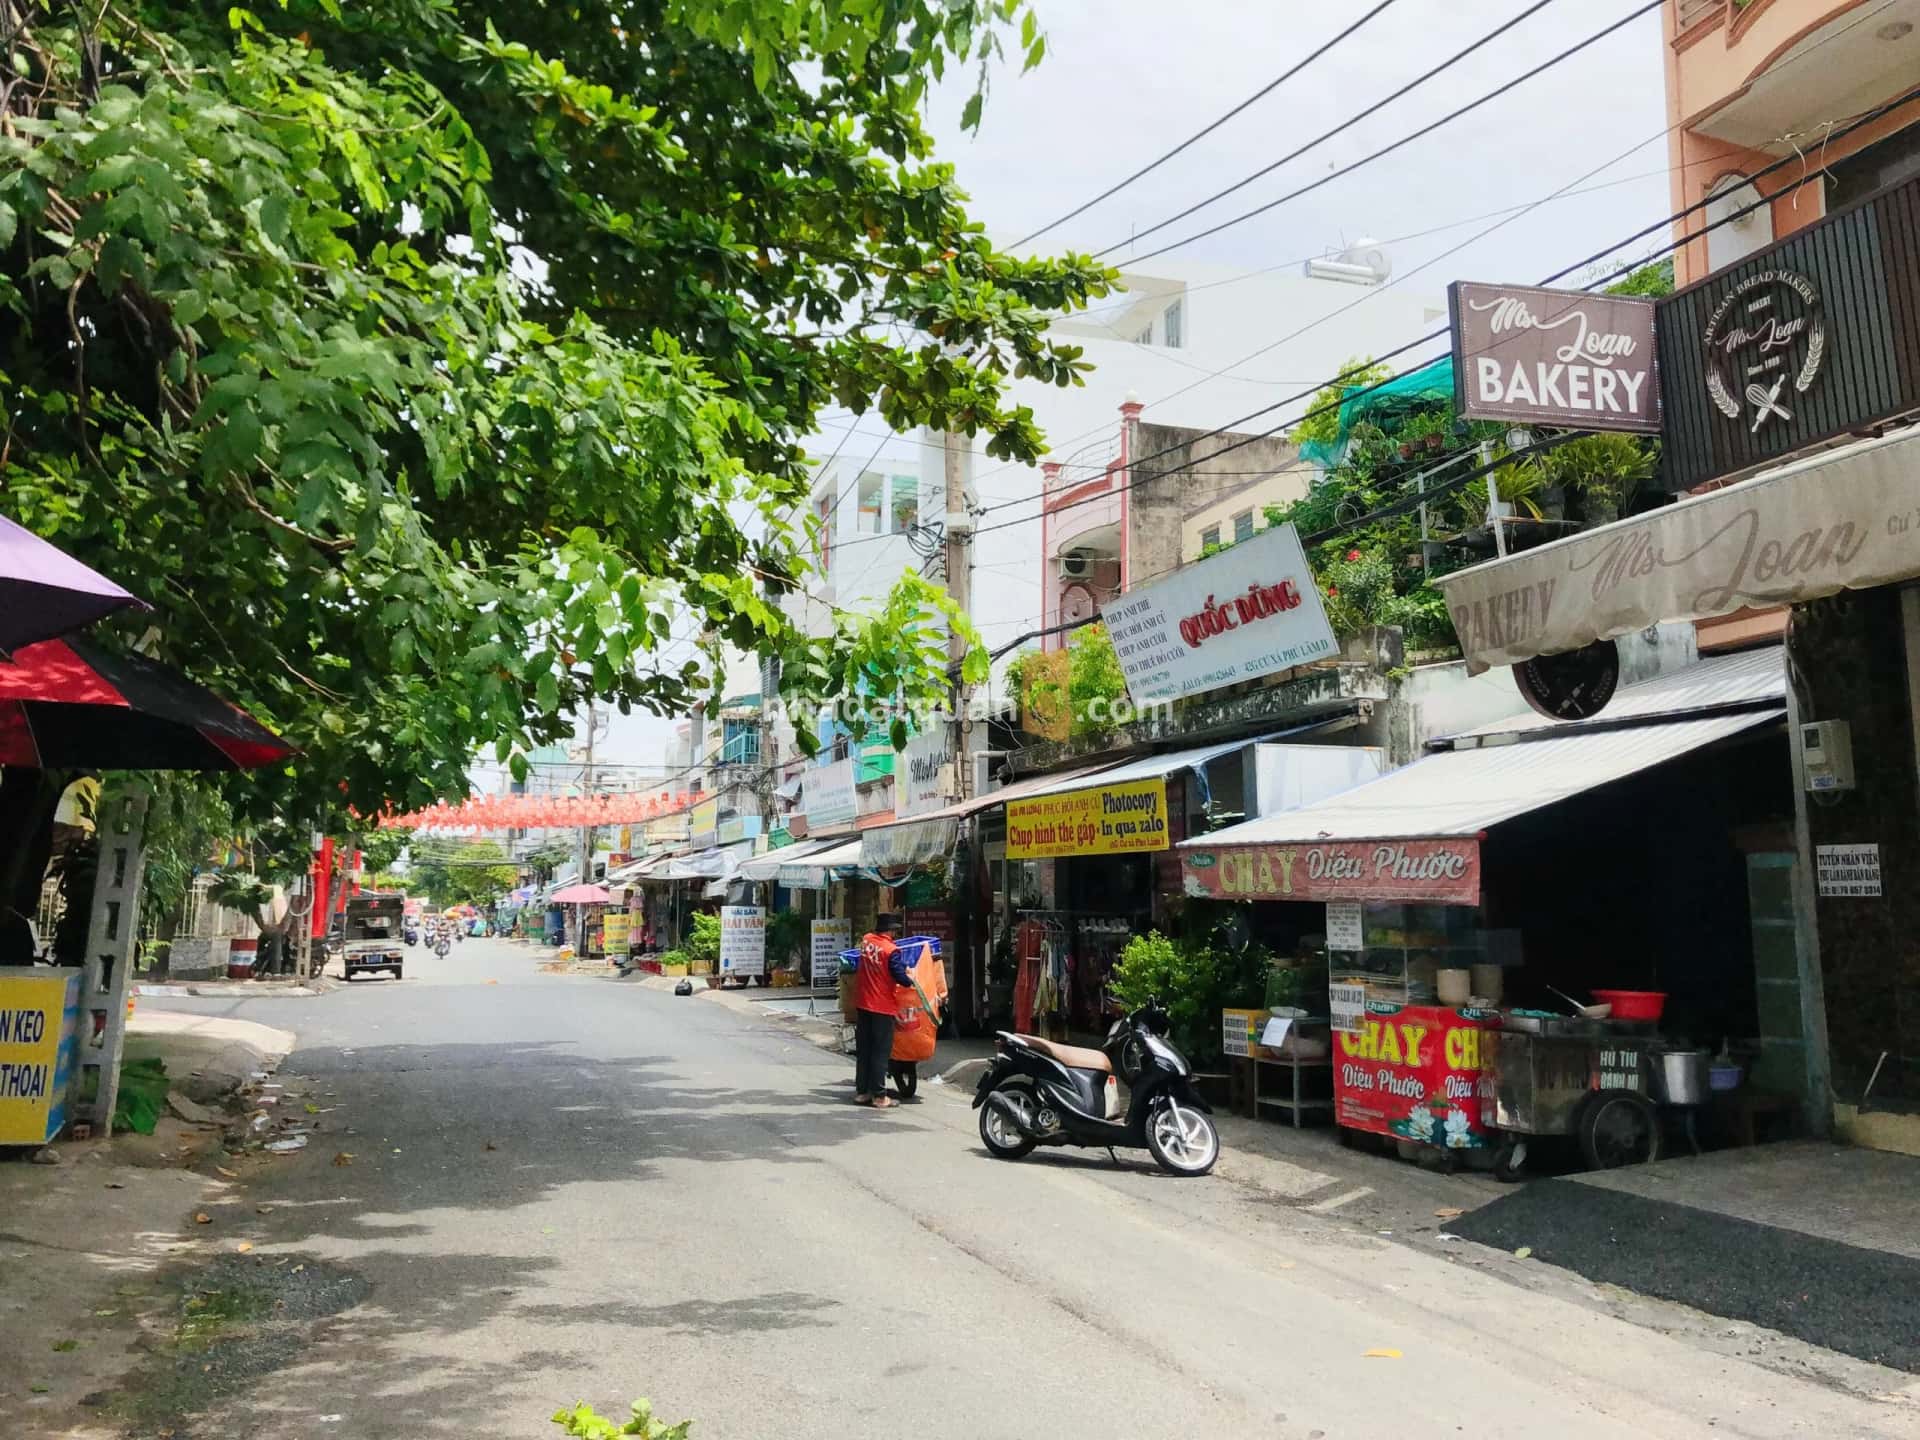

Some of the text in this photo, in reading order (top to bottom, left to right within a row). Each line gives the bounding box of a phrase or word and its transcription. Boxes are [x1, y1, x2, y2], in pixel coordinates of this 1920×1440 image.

[1704, 270, 1815, 345] ARTISAN BREAD MAKERS
[1748, 295, 1771, 312] BAKERY
[1469, 296, 1638, 367] Ms Loan
[1759, 318, 1806, 353] Loan
[1477, 356, 1646, 414] BAKERY
[1691, 508, 1870, 612] Loan
[1179, 594, 1239, 648] QUỐC
[1102, 791, 1157, 815] Photocopy
[1010, 811, 1096, 852] Chụp hình thẻ gấp
[1102, 814, 1164, 839] In qua zalo
[1219, 852, 1297, 894] CHAY
[1372, 845, 1467, 881] Phước
[13, 1010, 46, 1043] KEO
[1340, 1019, 1427, 1068] CHAY
[1445, 1026, 1485, 1071] CH
[1342, 1062, 1425, 1099] Diệu Phước
[1445, 1074, 1474, 1102] Diệu
